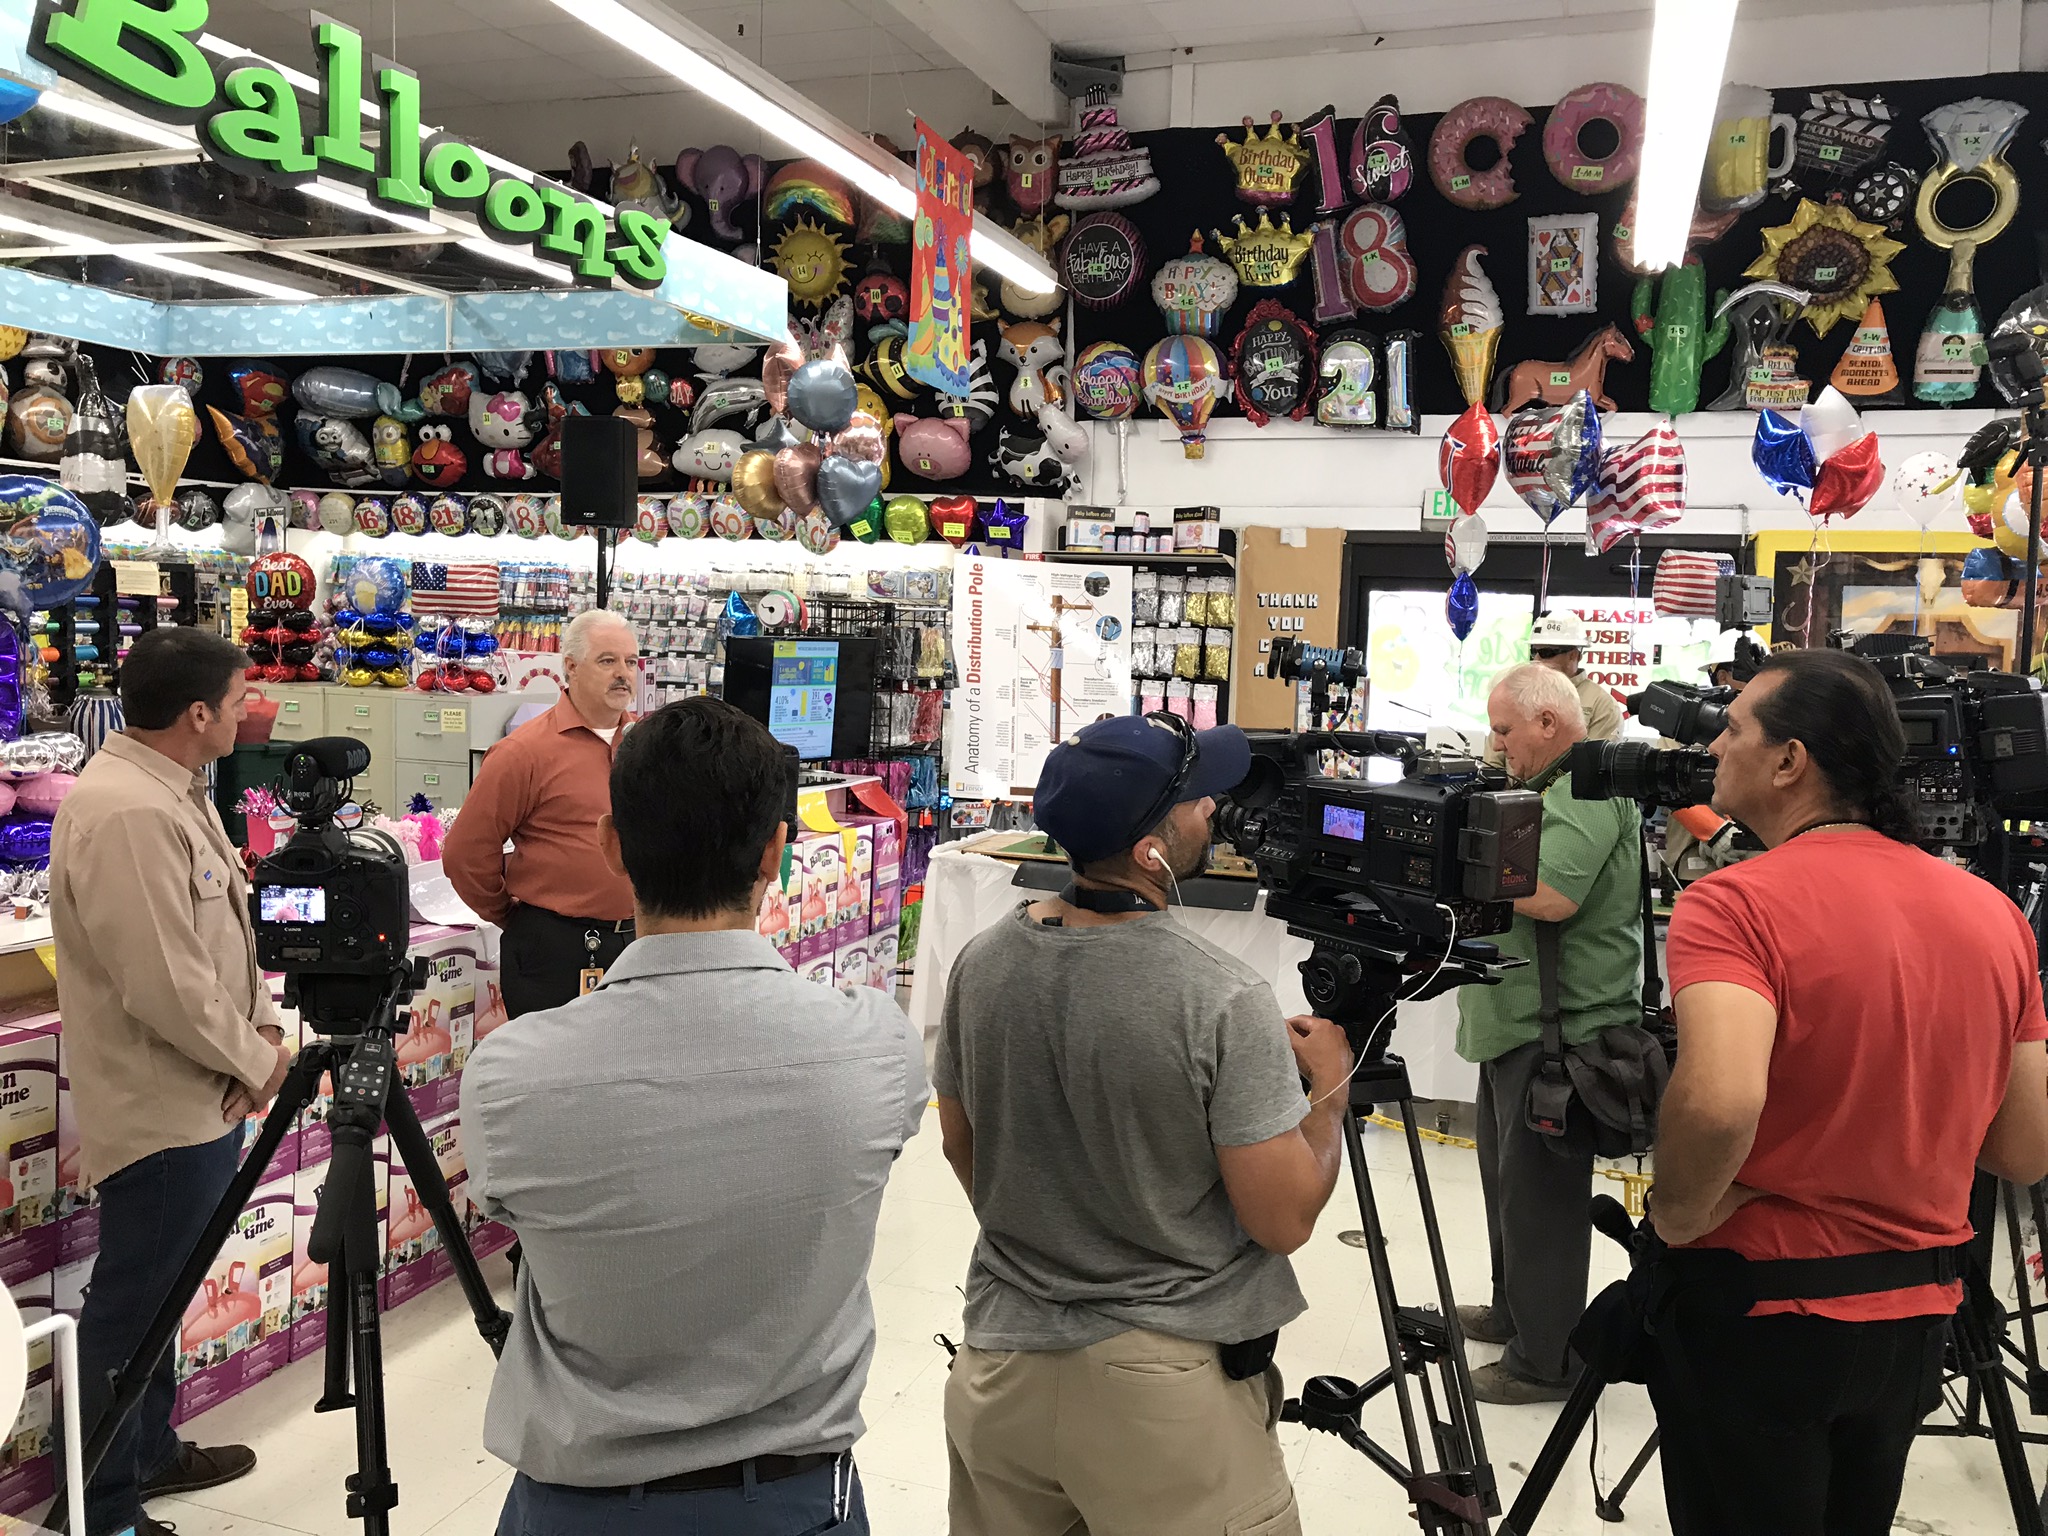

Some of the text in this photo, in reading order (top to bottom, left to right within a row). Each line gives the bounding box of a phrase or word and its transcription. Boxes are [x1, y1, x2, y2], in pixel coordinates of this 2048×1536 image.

[45, 0, 671, 282] Balloons
[1729, 135, 1745, 143] 1-R
[1803, 123, 1875, 149] HOLLYWOOD
[1963, 136, 1981, 145] 1-X
[1302, 105, 1412, 214] 16
[1823, 148, 1838, 157] 1-T
[1240, 148, 1295, 172] Birthday
[1352, 146, 1410, 194] Sweet
[1024, 175, 1030, 185] 1
[1453, 178, 1470, 188] 1-M
[710, 201, 718, 209] 17
[1079, 241, 1121, 253] HAVE A
[1235, 244, 1289, 263] Birthday
[1364, 253, 1378, 262] 1-K
[797, 266, 806, 275] 14
[1257, 263, 1271, 271] 1-H
[1314, 210, 1410, 320] 18
[1168, 266, 1213, 279] HAPPY
[1818, 270, 1834, 279] 1-U
[872, 291, 880, 299] 10
[1453, 325, 1468, 333] 1-N
[1670, 327, 1685, 335] 1-S
[1252, 331, 1290, 347] HAPPY
[1863, 333, 1881, 341] 1-W
[617, 352, 627, 361] 24
[1851, 345, 1887, 354] CAUTION
[1945, 348, 1962, 356] 1-Y
[1841, 369, 1889, 377] MOMENTS
[1022, 379, 1029, 387] 3
[1079, 373, 1124, 388] Happy
[1318, 341, 1412, 427] 21
[1847, 377, 1880, 386] AHEAD
[1262, 384, 1292, 401] You
[1764, 390, 1785, 398] JUST
[1433, 491, 1458, 517] EXI
[670, 507, 699, 530] 50
[712, 512, 742, 536] 60
[261, 559, 291, 571] Best
[255, 570, 302, 597] DAD
[263, 597, 295, 610] Ever
[1258, 593, 1319, 608] THANK
[1268, 616, 1304, 631] YOU
[1546, 623, 1561, 631] 046
[1585, 630, 1630, 644] USE
[1908, 643, 1930, 651] zylight
[1583, 651, 1647, 666] THER
[964, 563, 984, 774] Anatomy of a Distribution Pole
[1587, 671, 1639, 686] OOR
[810, 850, 830, 869] Balloon
[428, 956, 456, 978] lloon
[841, 952, 860, 973] Balloon
[440, 966, 463, 983] time
[807, 968, 825, 983] alloon
[428, 1128, 451, 1151] loon
[436, 1138, 457, 1157] time
[244, 1216, 275, 1240] time
